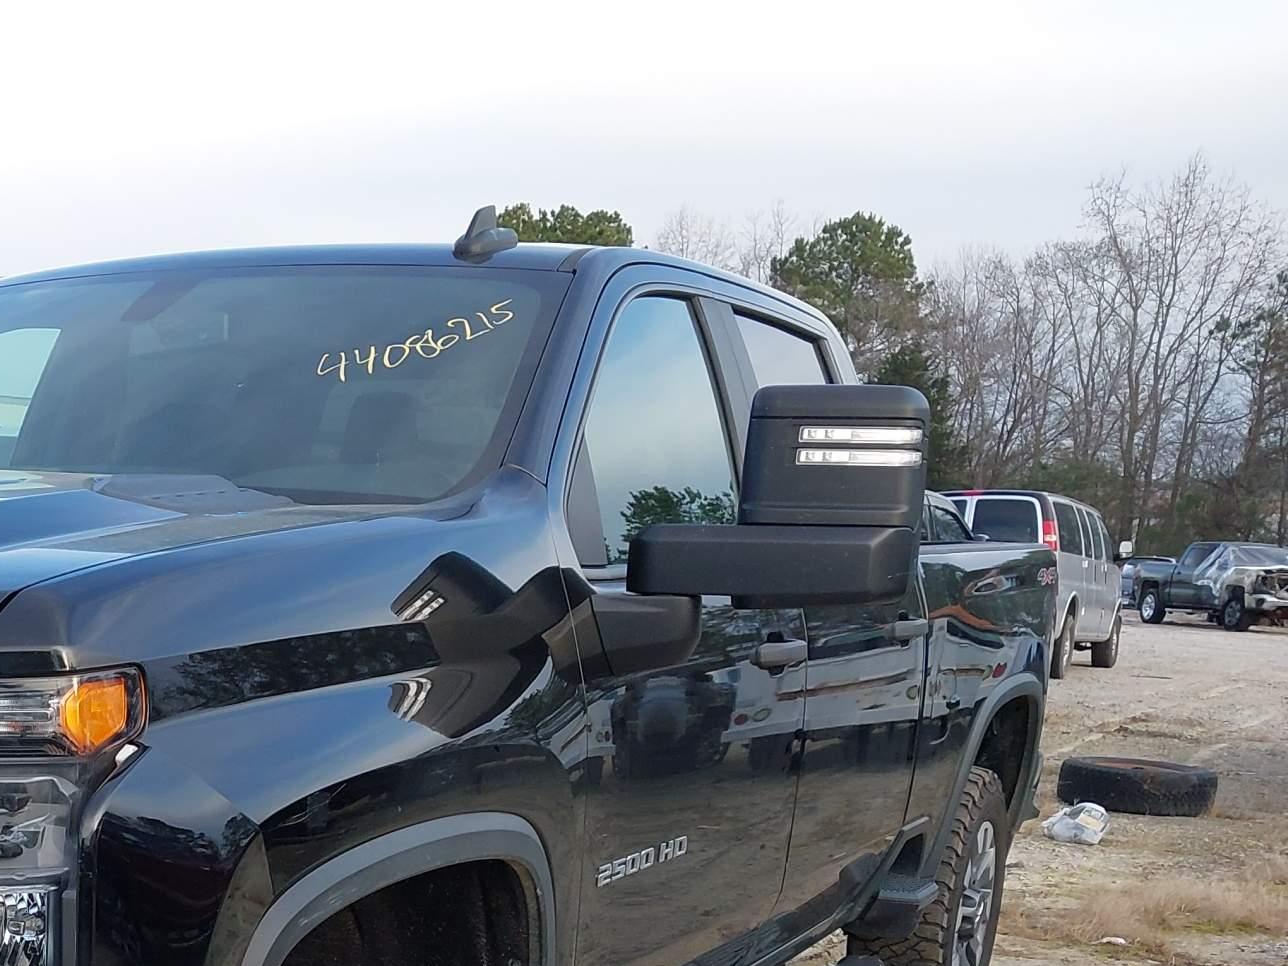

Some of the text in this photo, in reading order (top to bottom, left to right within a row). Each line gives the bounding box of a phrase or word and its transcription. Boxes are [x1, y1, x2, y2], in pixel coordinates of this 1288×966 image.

[316, 299, 513, 382] 44086215
[596, 835, 688, 888] 2500 HD
